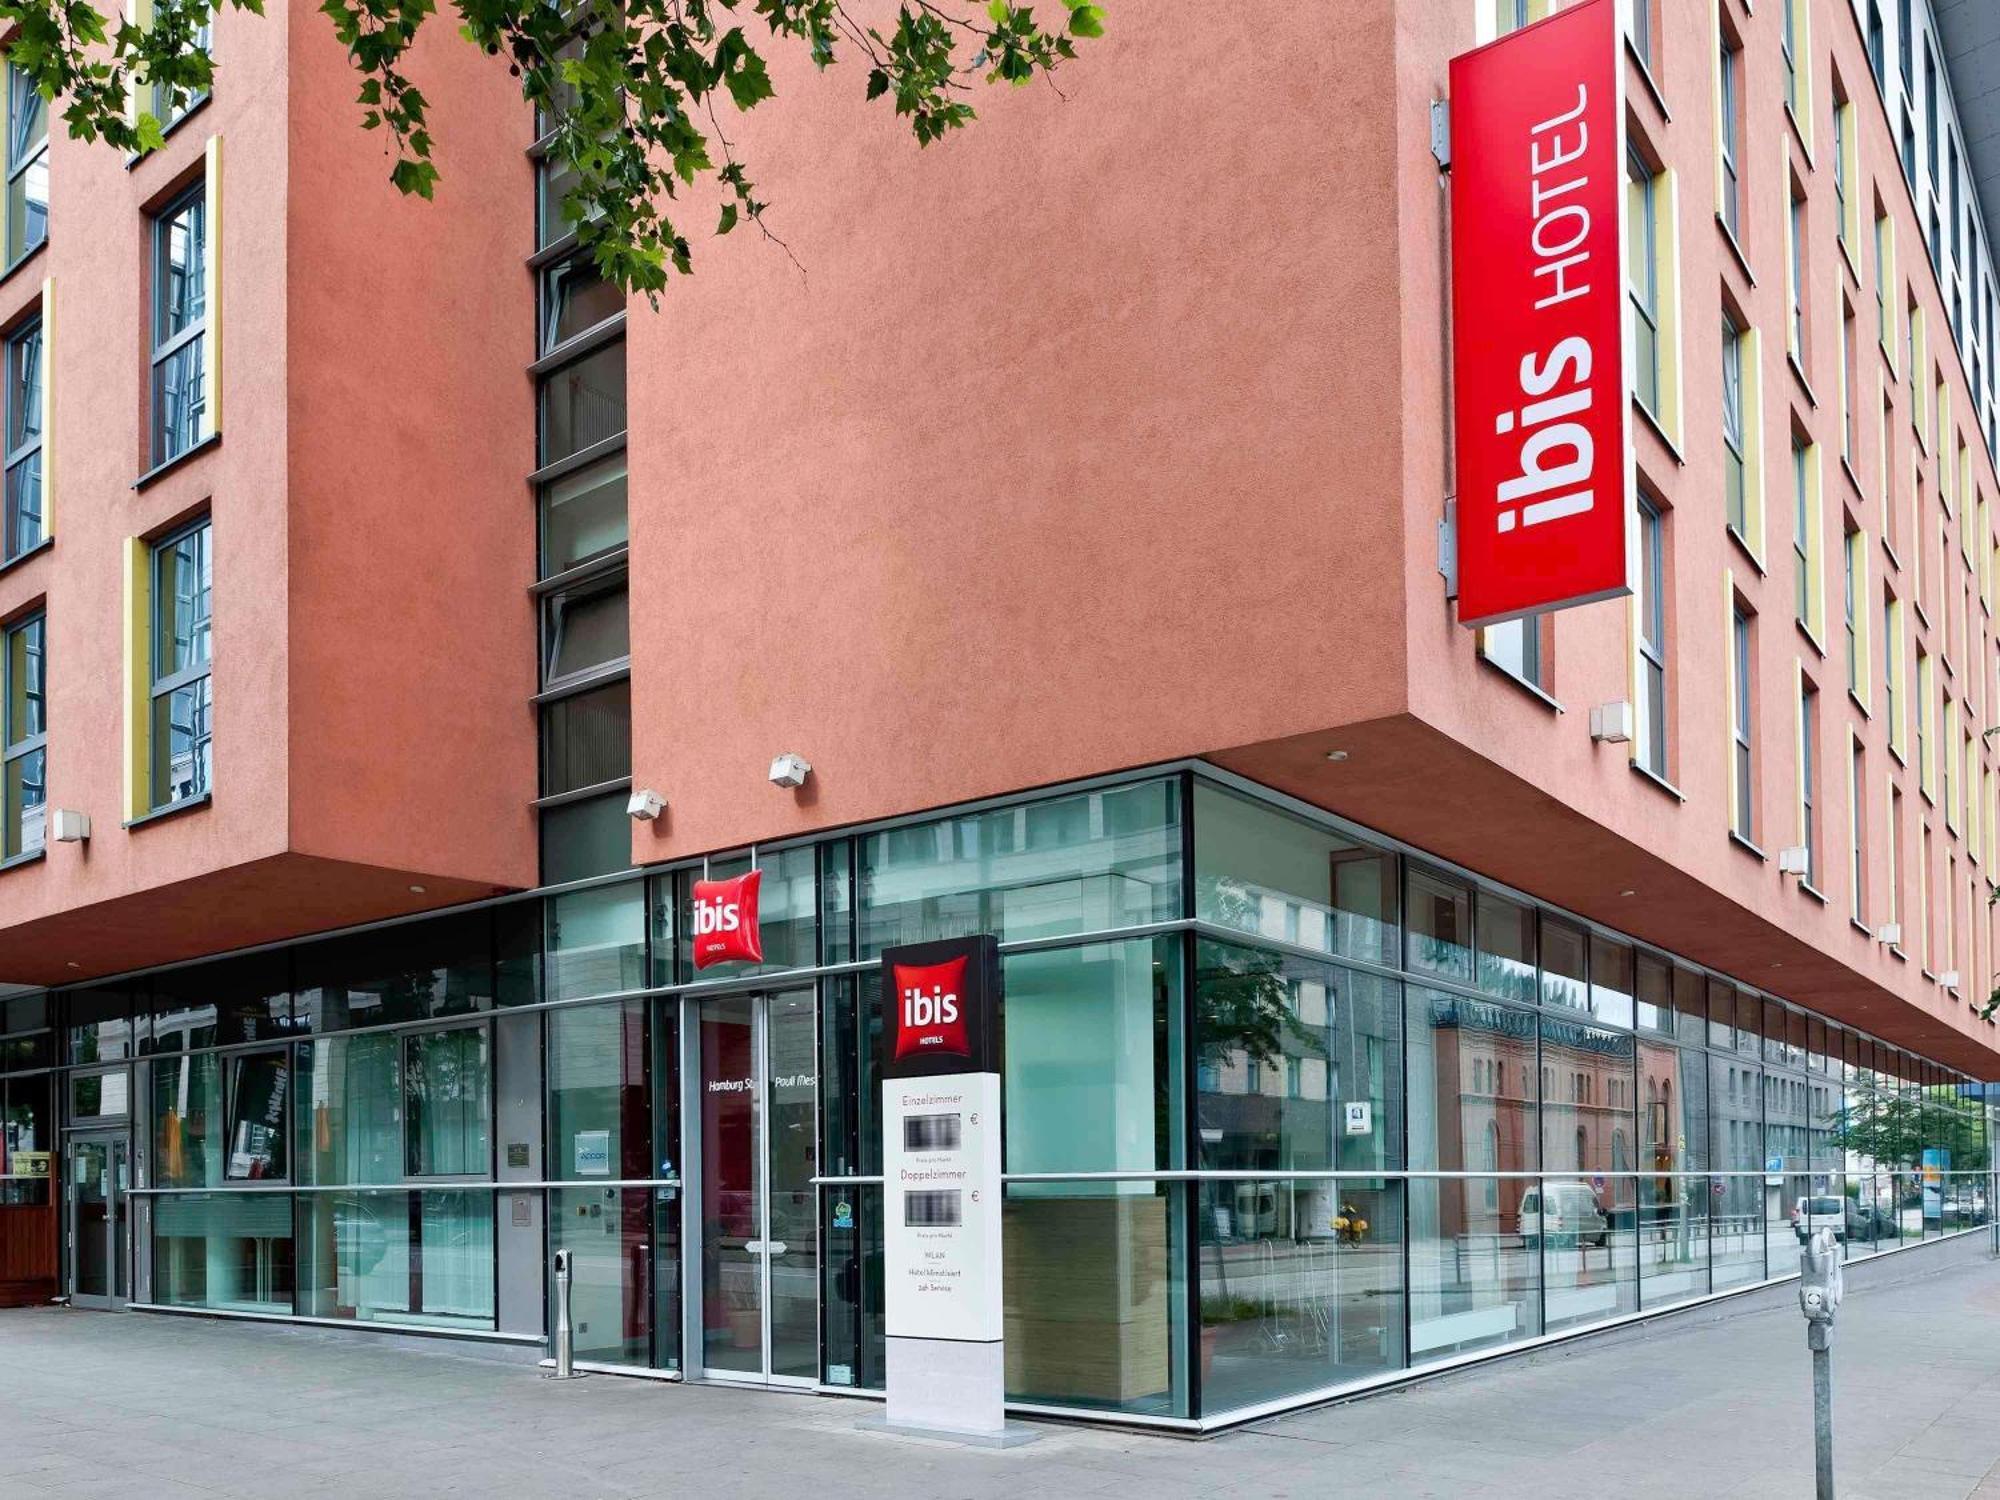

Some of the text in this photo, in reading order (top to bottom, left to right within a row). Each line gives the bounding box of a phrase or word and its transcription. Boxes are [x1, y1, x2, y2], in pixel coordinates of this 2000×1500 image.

[1495, 83, 1594, 533] ibis HOTEL
[694, 896, 740, 935] ibis
[904, 985, 959, 1028] ibis
[919, 1035, 944, 1045] HOTELS
[708, 1079, 743, 1092] Hamburg
[902, 1093, 963, 1106] Einzelzimmer
[970, 1112, 979, 1125] €
[900, 1167, 967, 1183] Doppelzimmer
[971, 1190, 980, 1202] €
